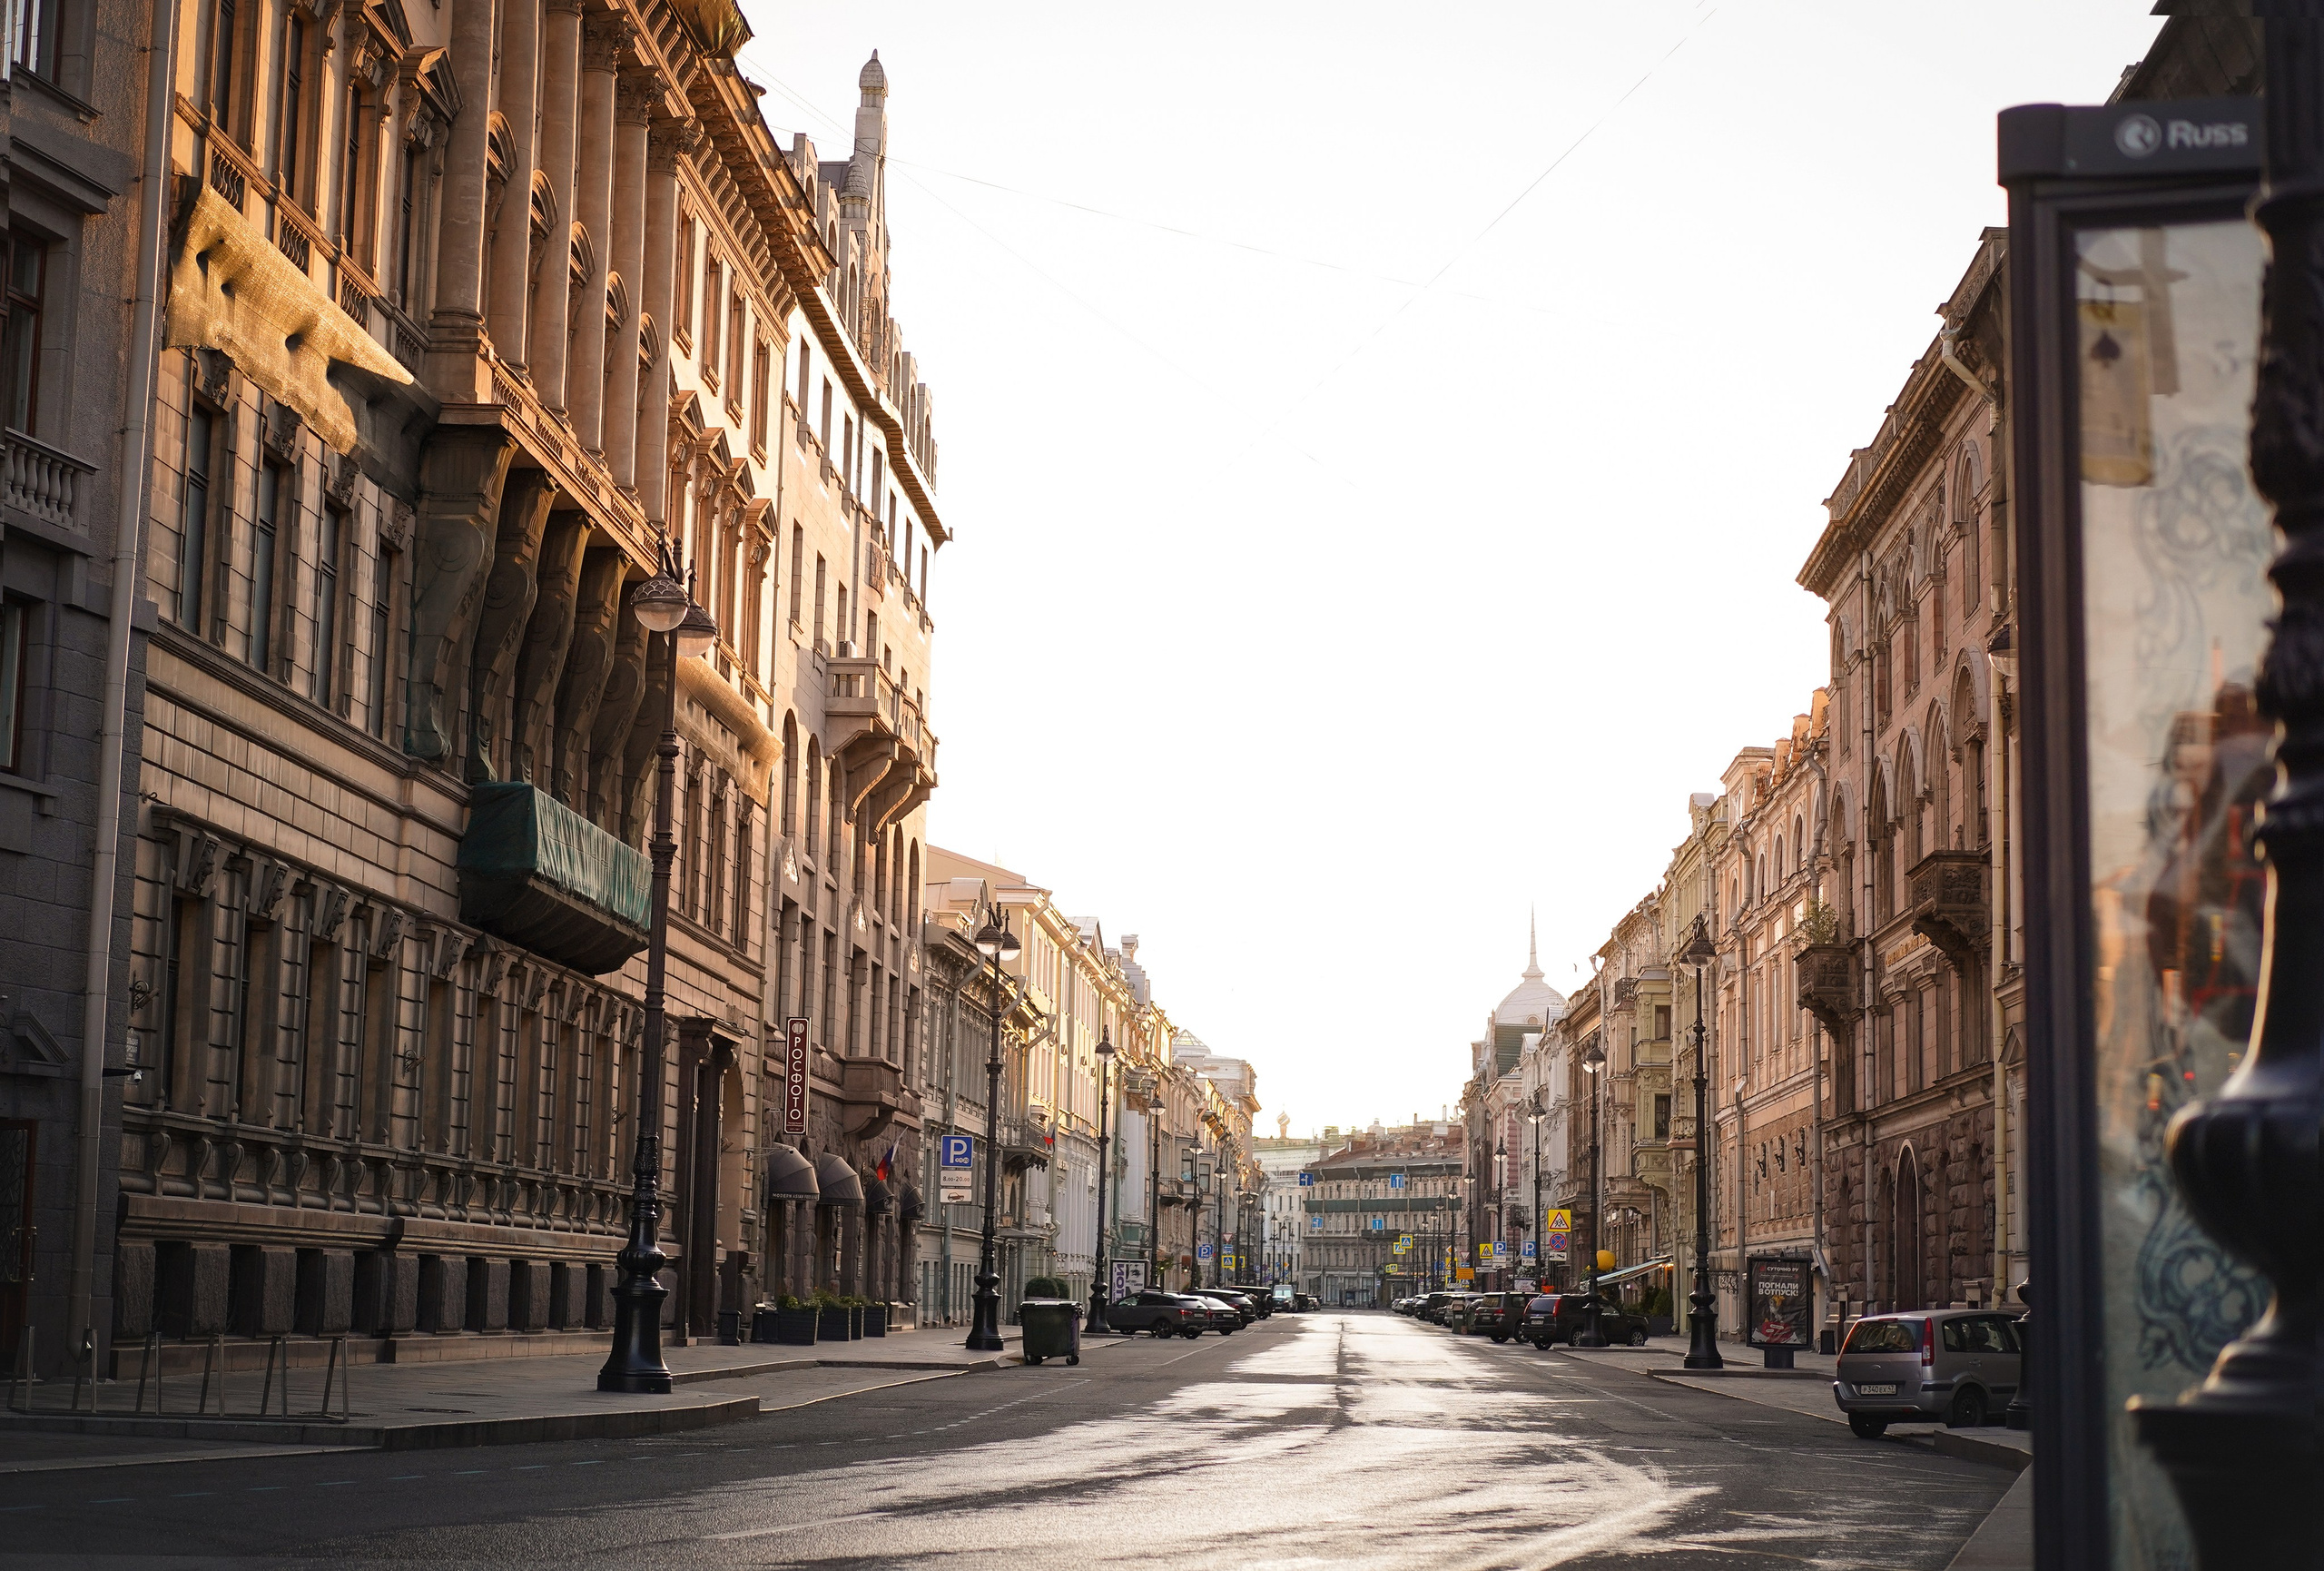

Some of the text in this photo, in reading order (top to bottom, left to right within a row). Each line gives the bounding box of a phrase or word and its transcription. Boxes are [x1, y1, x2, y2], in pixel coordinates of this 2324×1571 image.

[2167, 119, 2249, 150] Russ
[790, 1036, 803, 1121] РОСФОТО
[1758, 1281, 1799, 1290] ПОГНАЛИ
